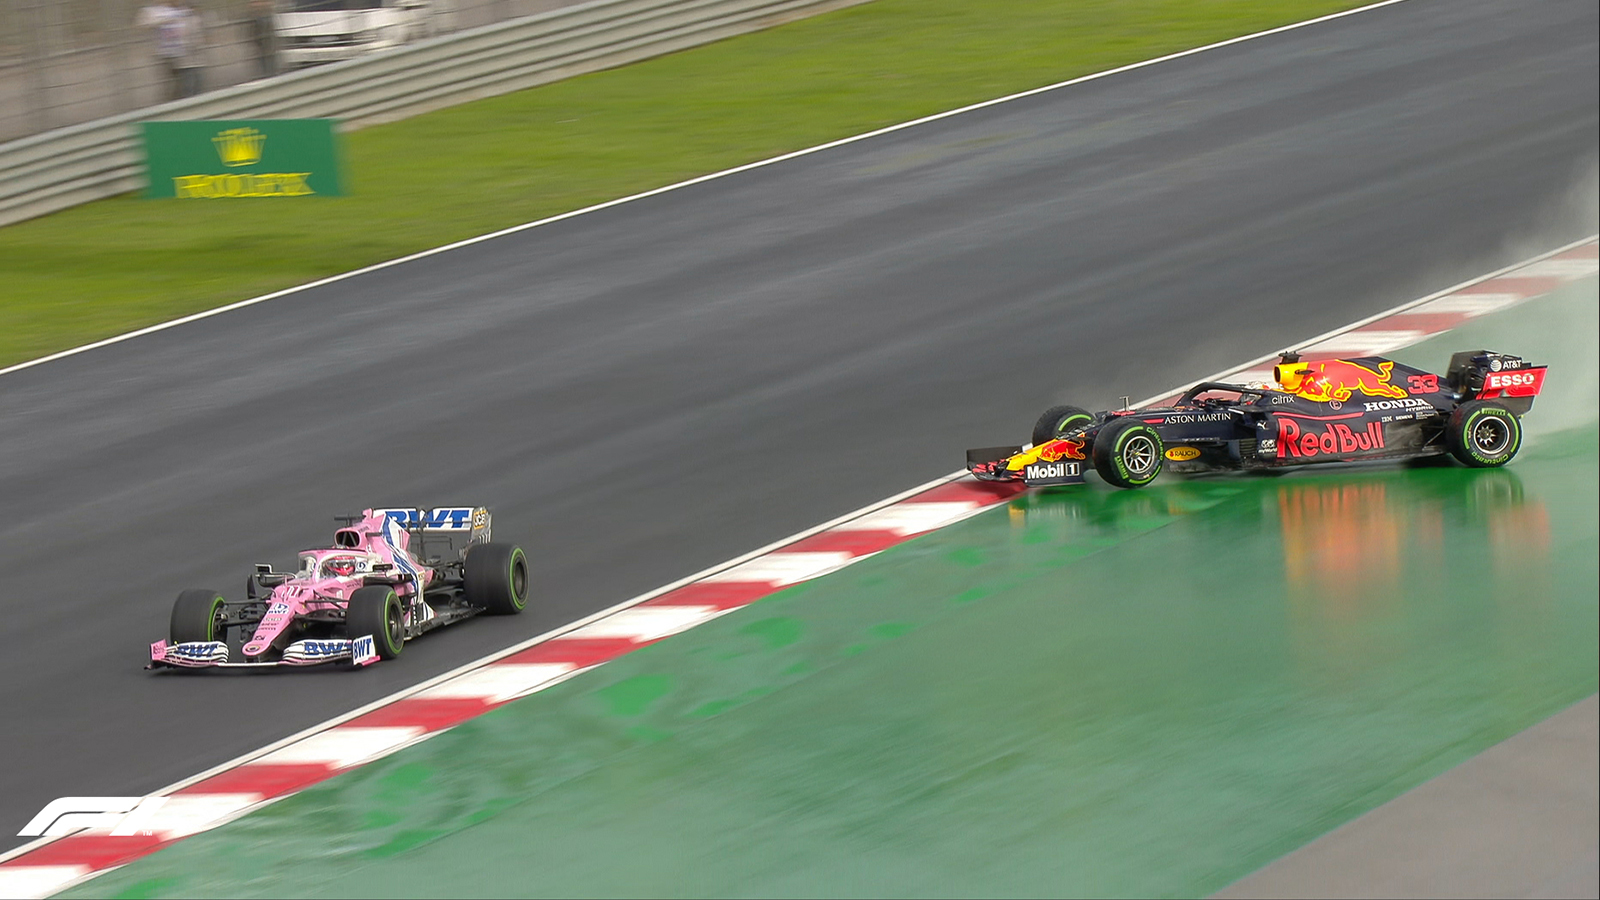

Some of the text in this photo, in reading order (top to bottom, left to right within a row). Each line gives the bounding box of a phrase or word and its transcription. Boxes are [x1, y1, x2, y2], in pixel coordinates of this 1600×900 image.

[1502, 360, 1522, 369] AT&T
[1407, 374, 1440, 394] 33
[1490, 373, 1535, 387] ESSO
[1271, 395, 1295, 405] citrix
[1363, 398, 1431, 412] HONDA
[1164, 413, 1231, 425] ASTON MARTIN
[1027, 464, 1064, 479] Mobil
[385, 509, 470, 529] BWT
[173, 643, 219, 658] BWT
[353, 638, 371, 660] BWT
